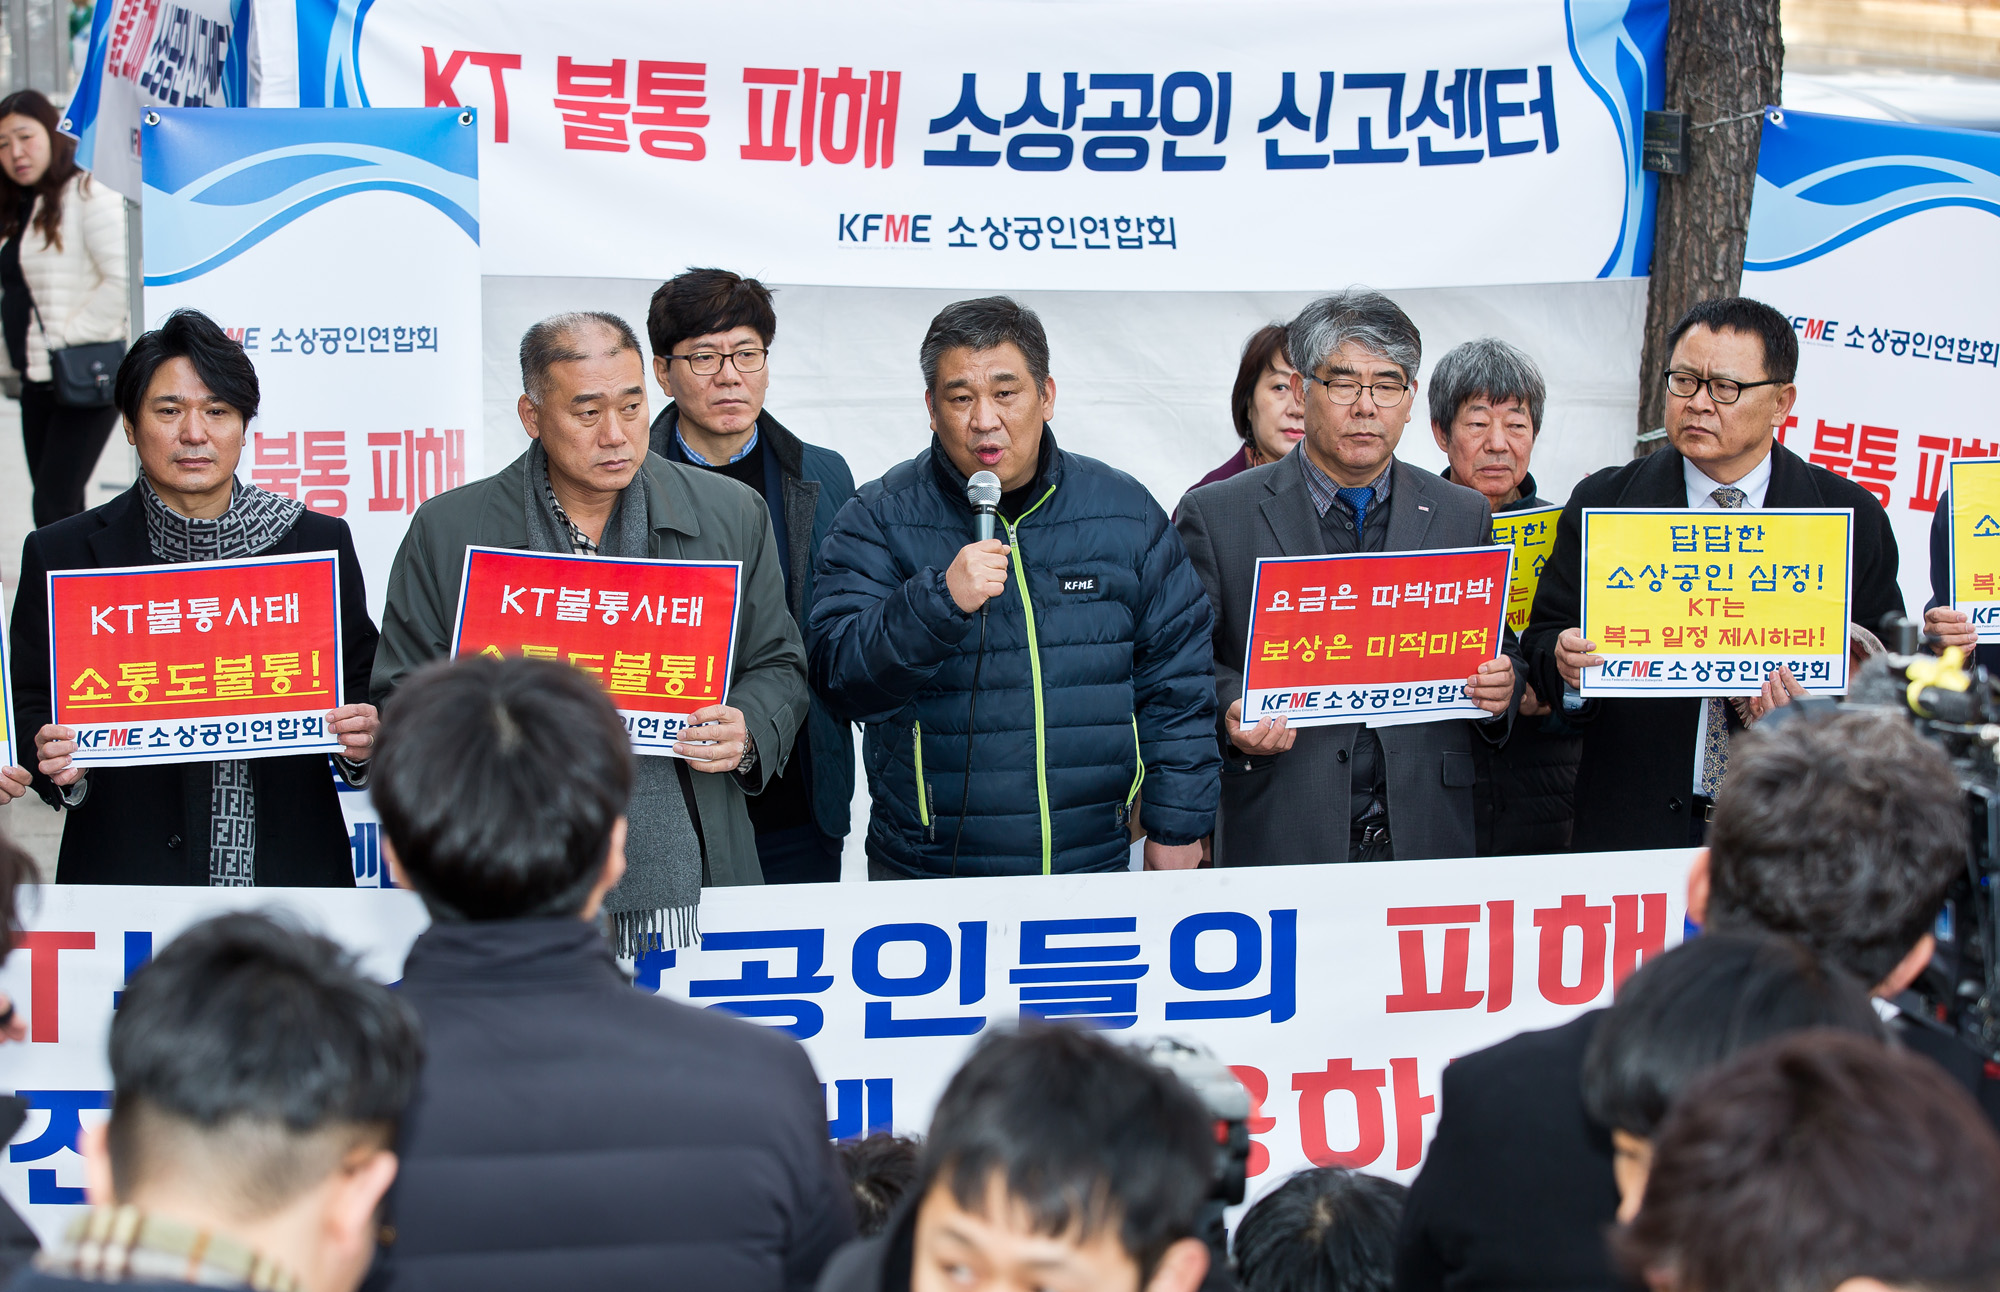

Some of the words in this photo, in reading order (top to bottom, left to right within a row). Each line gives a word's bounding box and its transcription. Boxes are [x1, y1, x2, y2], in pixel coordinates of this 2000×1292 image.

[421, 46, 522, 143] KT
[553, 55, 711, 161] 불통
[740, 66, 902, 169] 피해
[923, 71, 1232, 171] 소상공인
[1257, 65, 1560, 169] 신고센터
[838, 213, 932, 243] KFME
[948, 215, 1177, 251] 소상공인연합회
[270, 325, 439, 355] 소상공인연합회
[1787, 316, 1839, 342] FME
[1844, 325, 2000, 368] 소상공인연합회
[1670, 525, 1766, 553] 답답한
[1064, 579, 1095, 590] KFME
[1606, 563, 1734, 593] 소상공인
[1748, 563, 1824, 593] 심정!
[501, 584, 704, 627] KT불통사태
[1265, 583, 1359, 613] 요금은
[1371, 576, 1495, 609] 따박따박
[1688, 597, 1745, 618] KT는
[91, 592, 300, 636] KT불통사태
[1260, 634, 1354, 663] 보상은
[1366, 627, 1489, 659] 미적미적
[1603, 625, 1651, 648] 복구
[1662, 625, 1708, 648] 일정
[1718, 626, 1825, 648] 제시하라!
[69, 650, 320, 703] 소통도불통!
[1601, 660, 1664, 678] KFME
[1667, 660, 1831, 683] 소상공인연합회
[1261, 691, 1321, 711] KFME
[76, 727, 144, 748] KFME
[148, 716, 324, 748] 소상공인연합회
